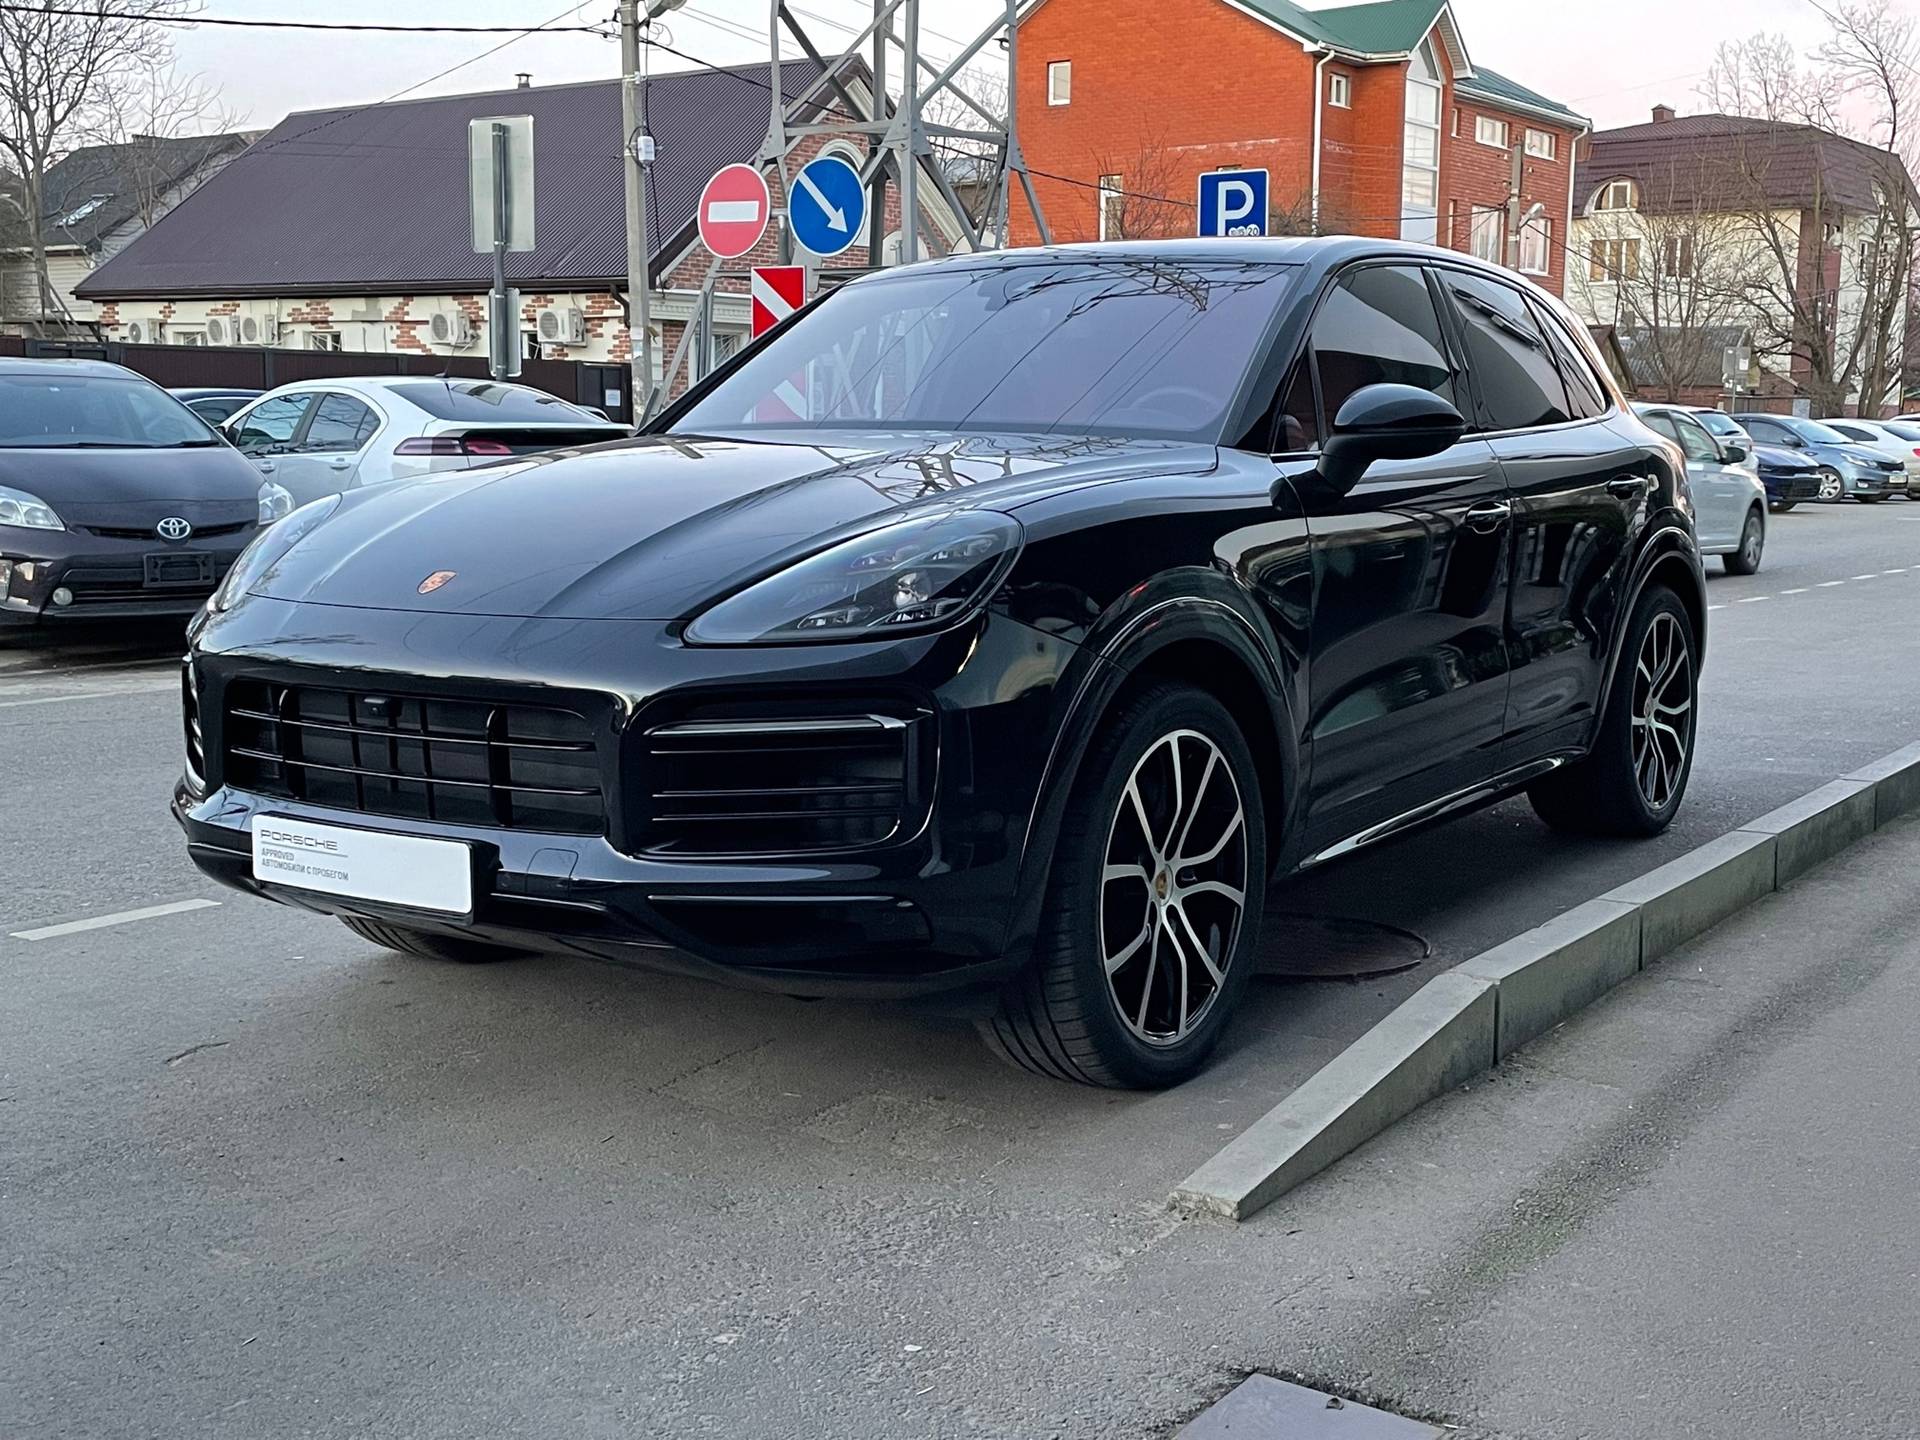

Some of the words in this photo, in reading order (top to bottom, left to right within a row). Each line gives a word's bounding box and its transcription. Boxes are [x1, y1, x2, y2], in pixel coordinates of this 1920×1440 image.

[1217, 181, 1254, 236] P
[261, 829, 338, 851] PORSCHE
[262, 847, 294, 861] APPROVED
[262, 858, 305, 873] АВТОМОБИЛИ
[312, 867, 349, 880] ПРОБЕГОМ
